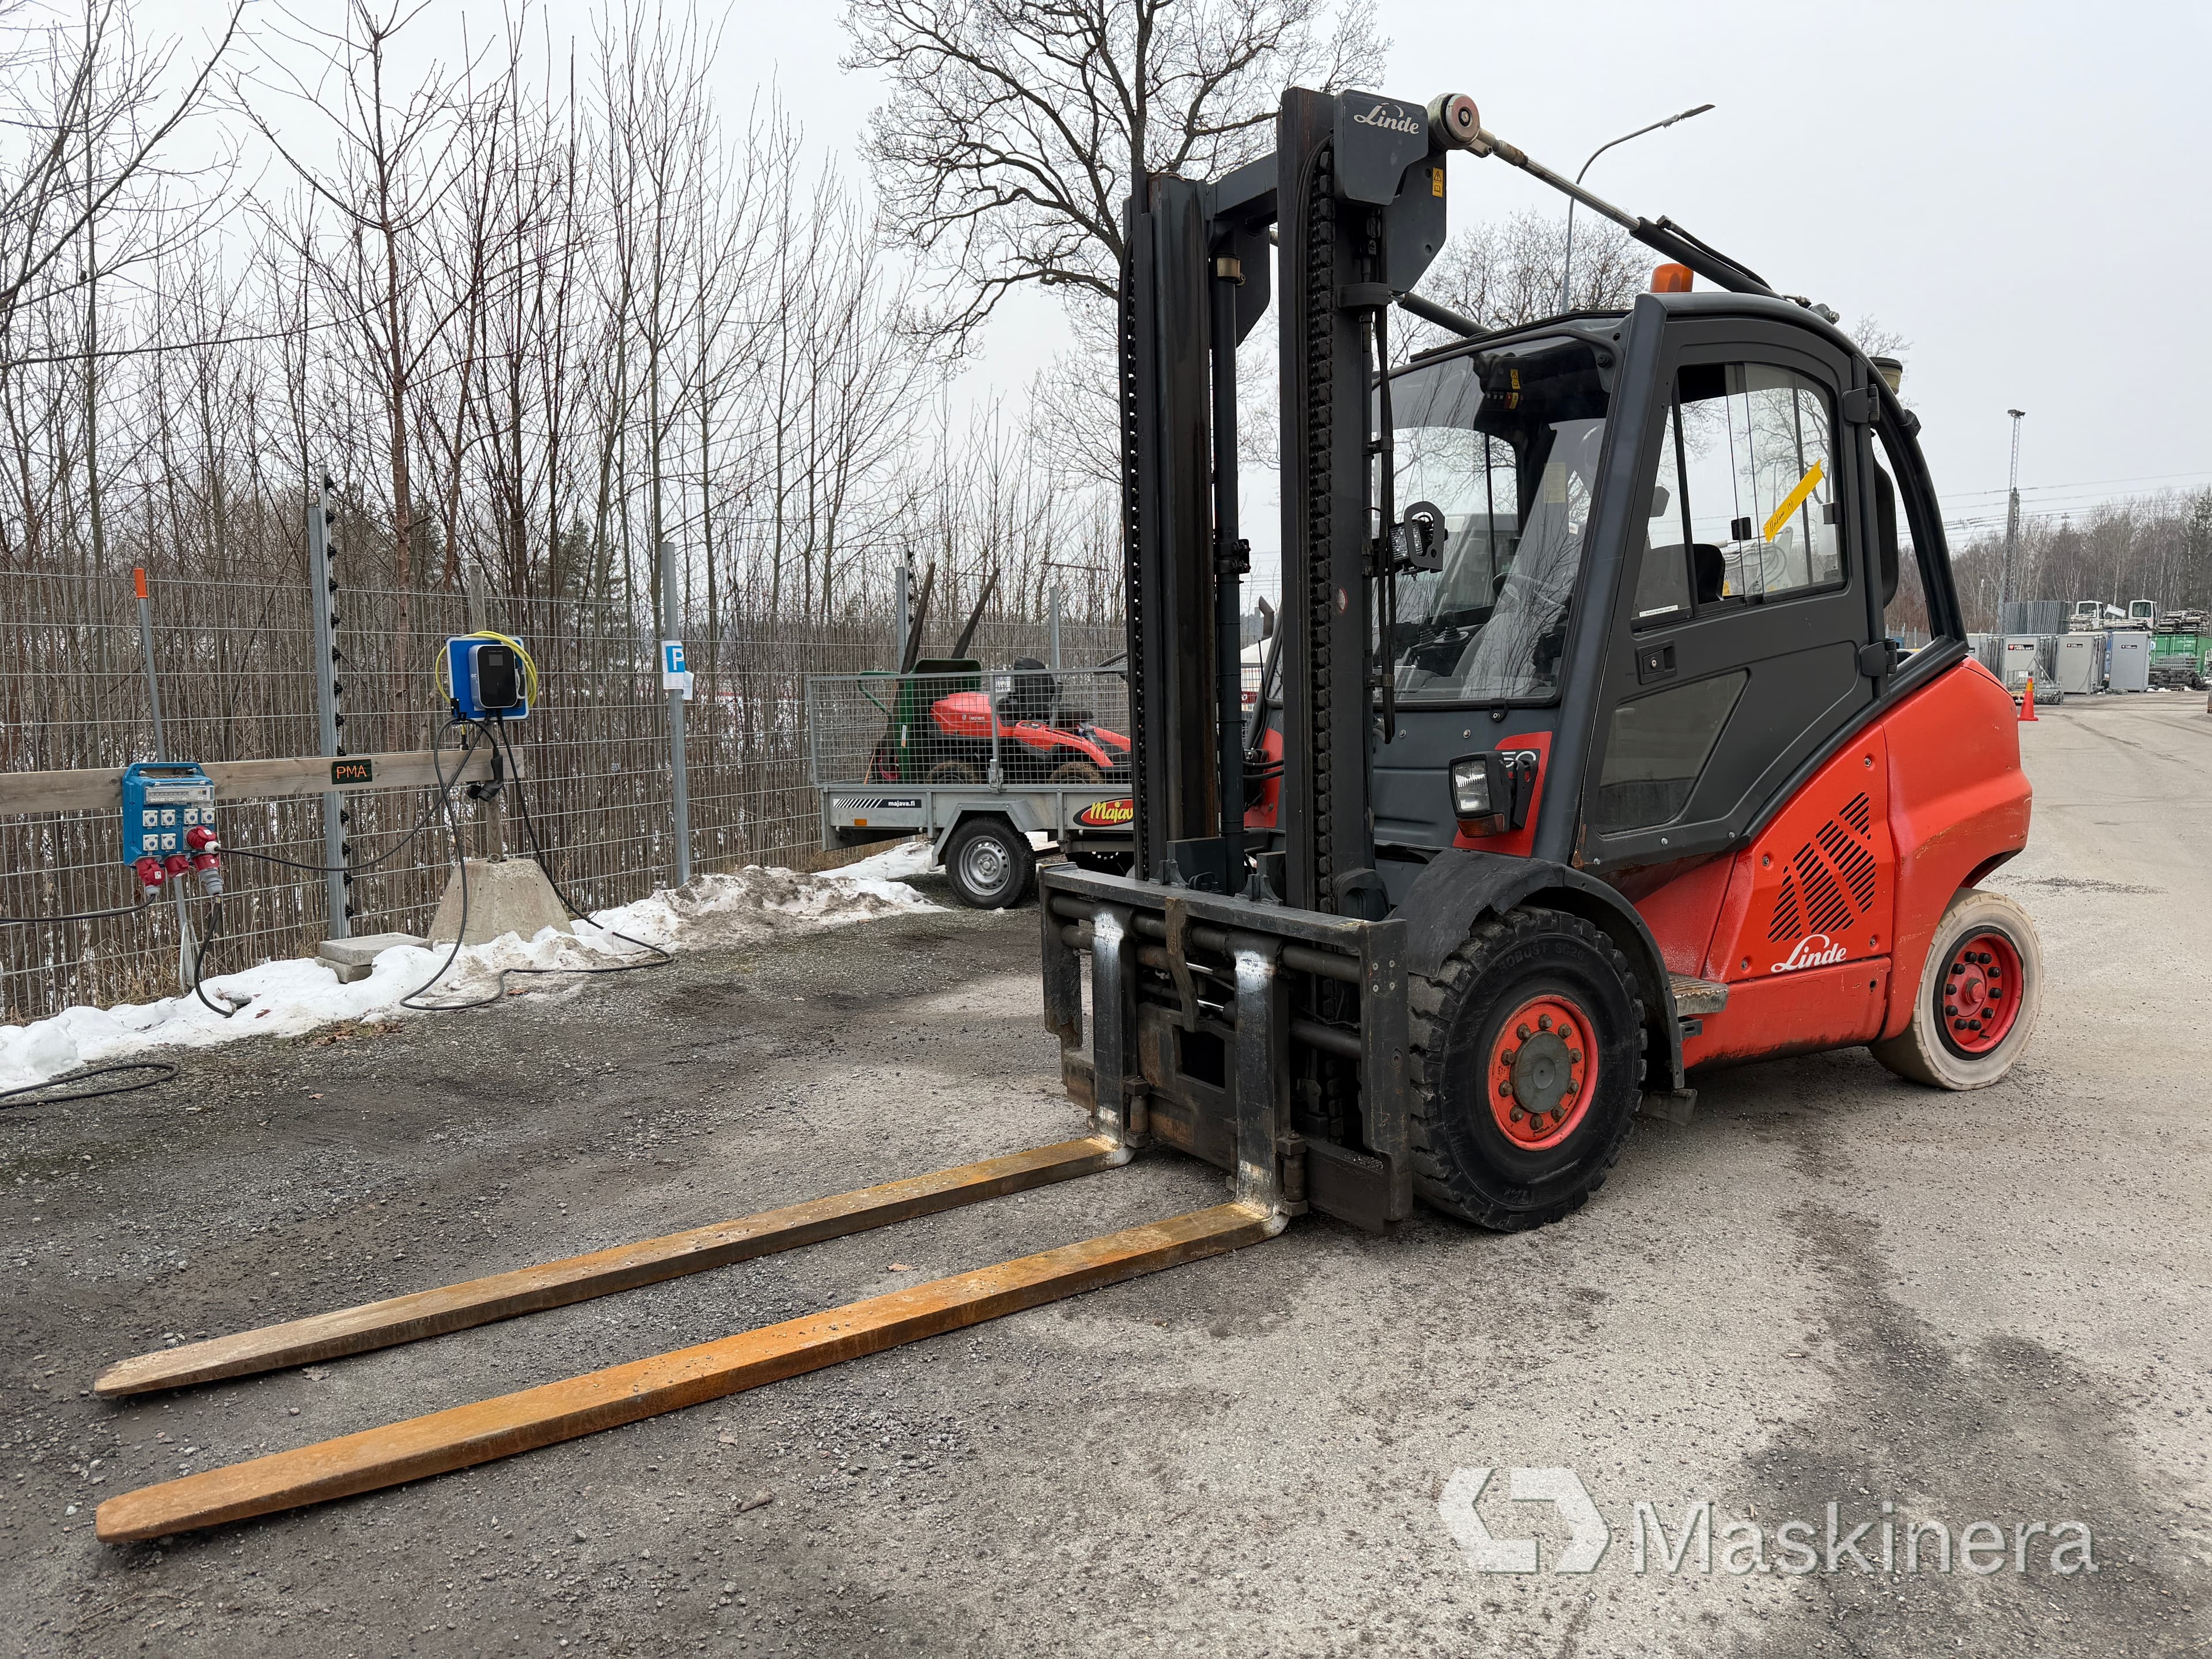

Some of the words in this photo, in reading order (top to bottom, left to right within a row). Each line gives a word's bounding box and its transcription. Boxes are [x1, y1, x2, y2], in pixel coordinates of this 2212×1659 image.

[1353, 102, 1419, 135] Linde
[672, 647, 684, 671] P
[336, 764, 368, 779] PMA
[1090, 801, 1134, 824] Majav
[1770, 933, 1847, 974] Linde
